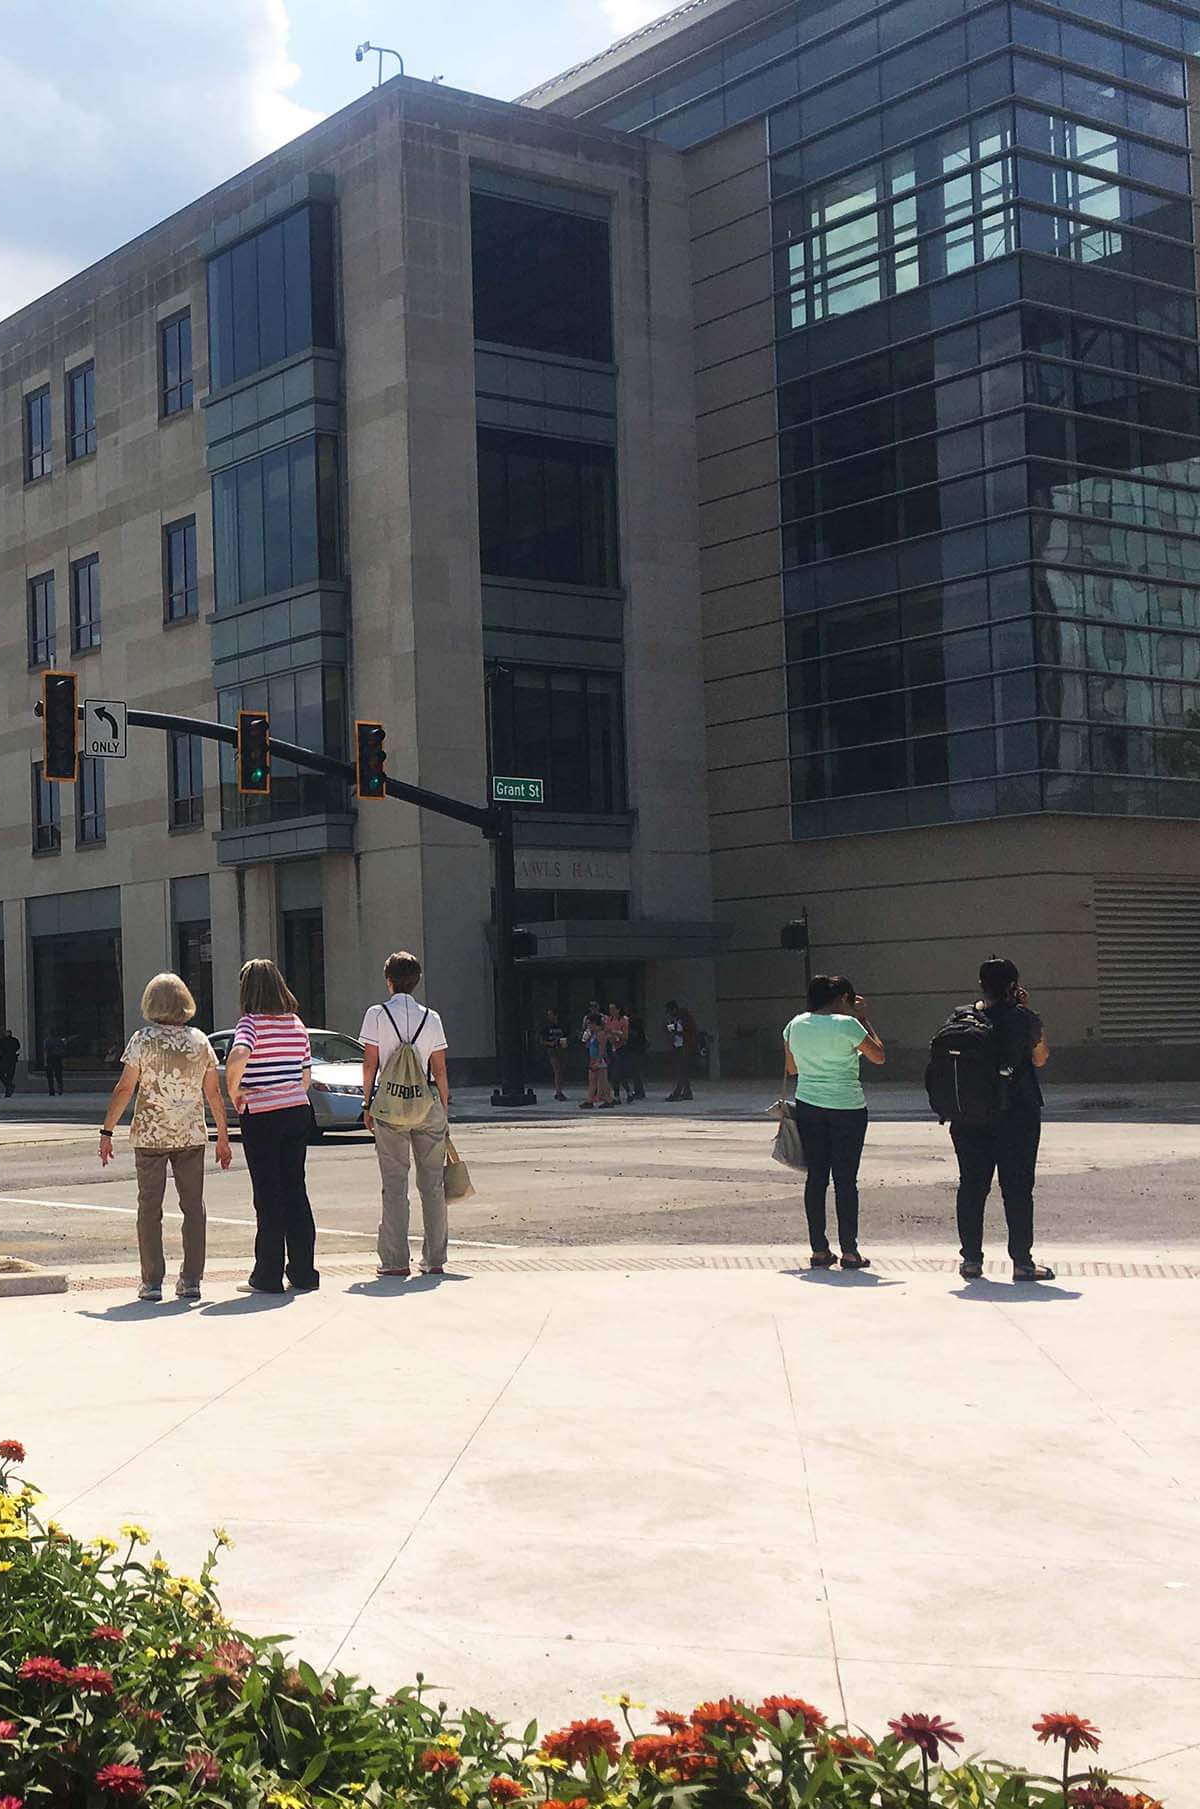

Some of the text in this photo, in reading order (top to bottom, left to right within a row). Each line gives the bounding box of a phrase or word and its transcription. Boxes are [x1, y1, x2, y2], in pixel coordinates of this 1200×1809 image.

[92, 741, 120, 753] ONLY
[496, 782, 540, 798] Grant St
[514, 861, 561, 879] AWLS
